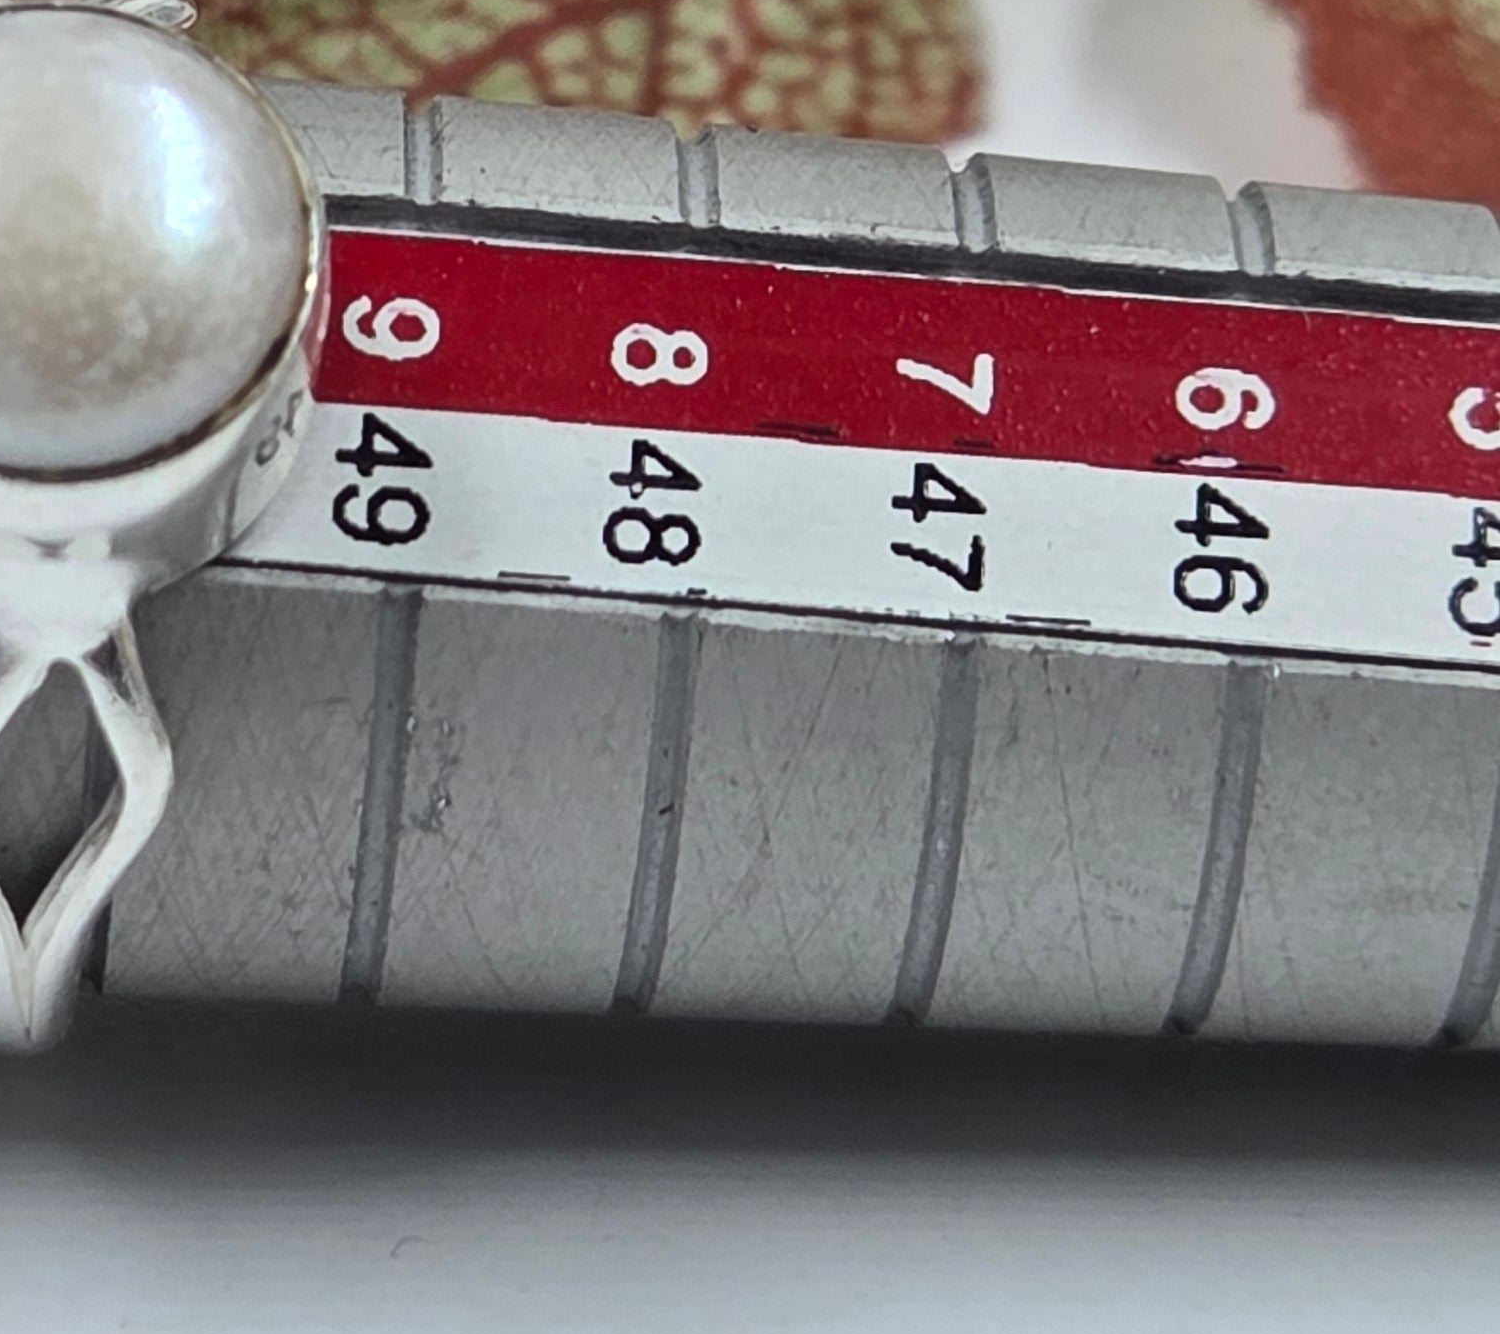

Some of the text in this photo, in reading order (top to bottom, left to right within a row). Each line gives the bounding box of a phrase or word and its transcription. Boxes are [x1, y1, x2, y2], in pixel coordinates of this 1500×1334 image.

[342, 295, 441, 362] 9
[610, 322, 709, 387] 8
[896, 353, 995, 415] 7
[1175, 366, 1276, 431] 6
[332, 412, 434, 547] 49
[602, 439, 702, 567] 48
[890, 462, 987, 592] 47
[1173, 482, 1270, 615] 46
